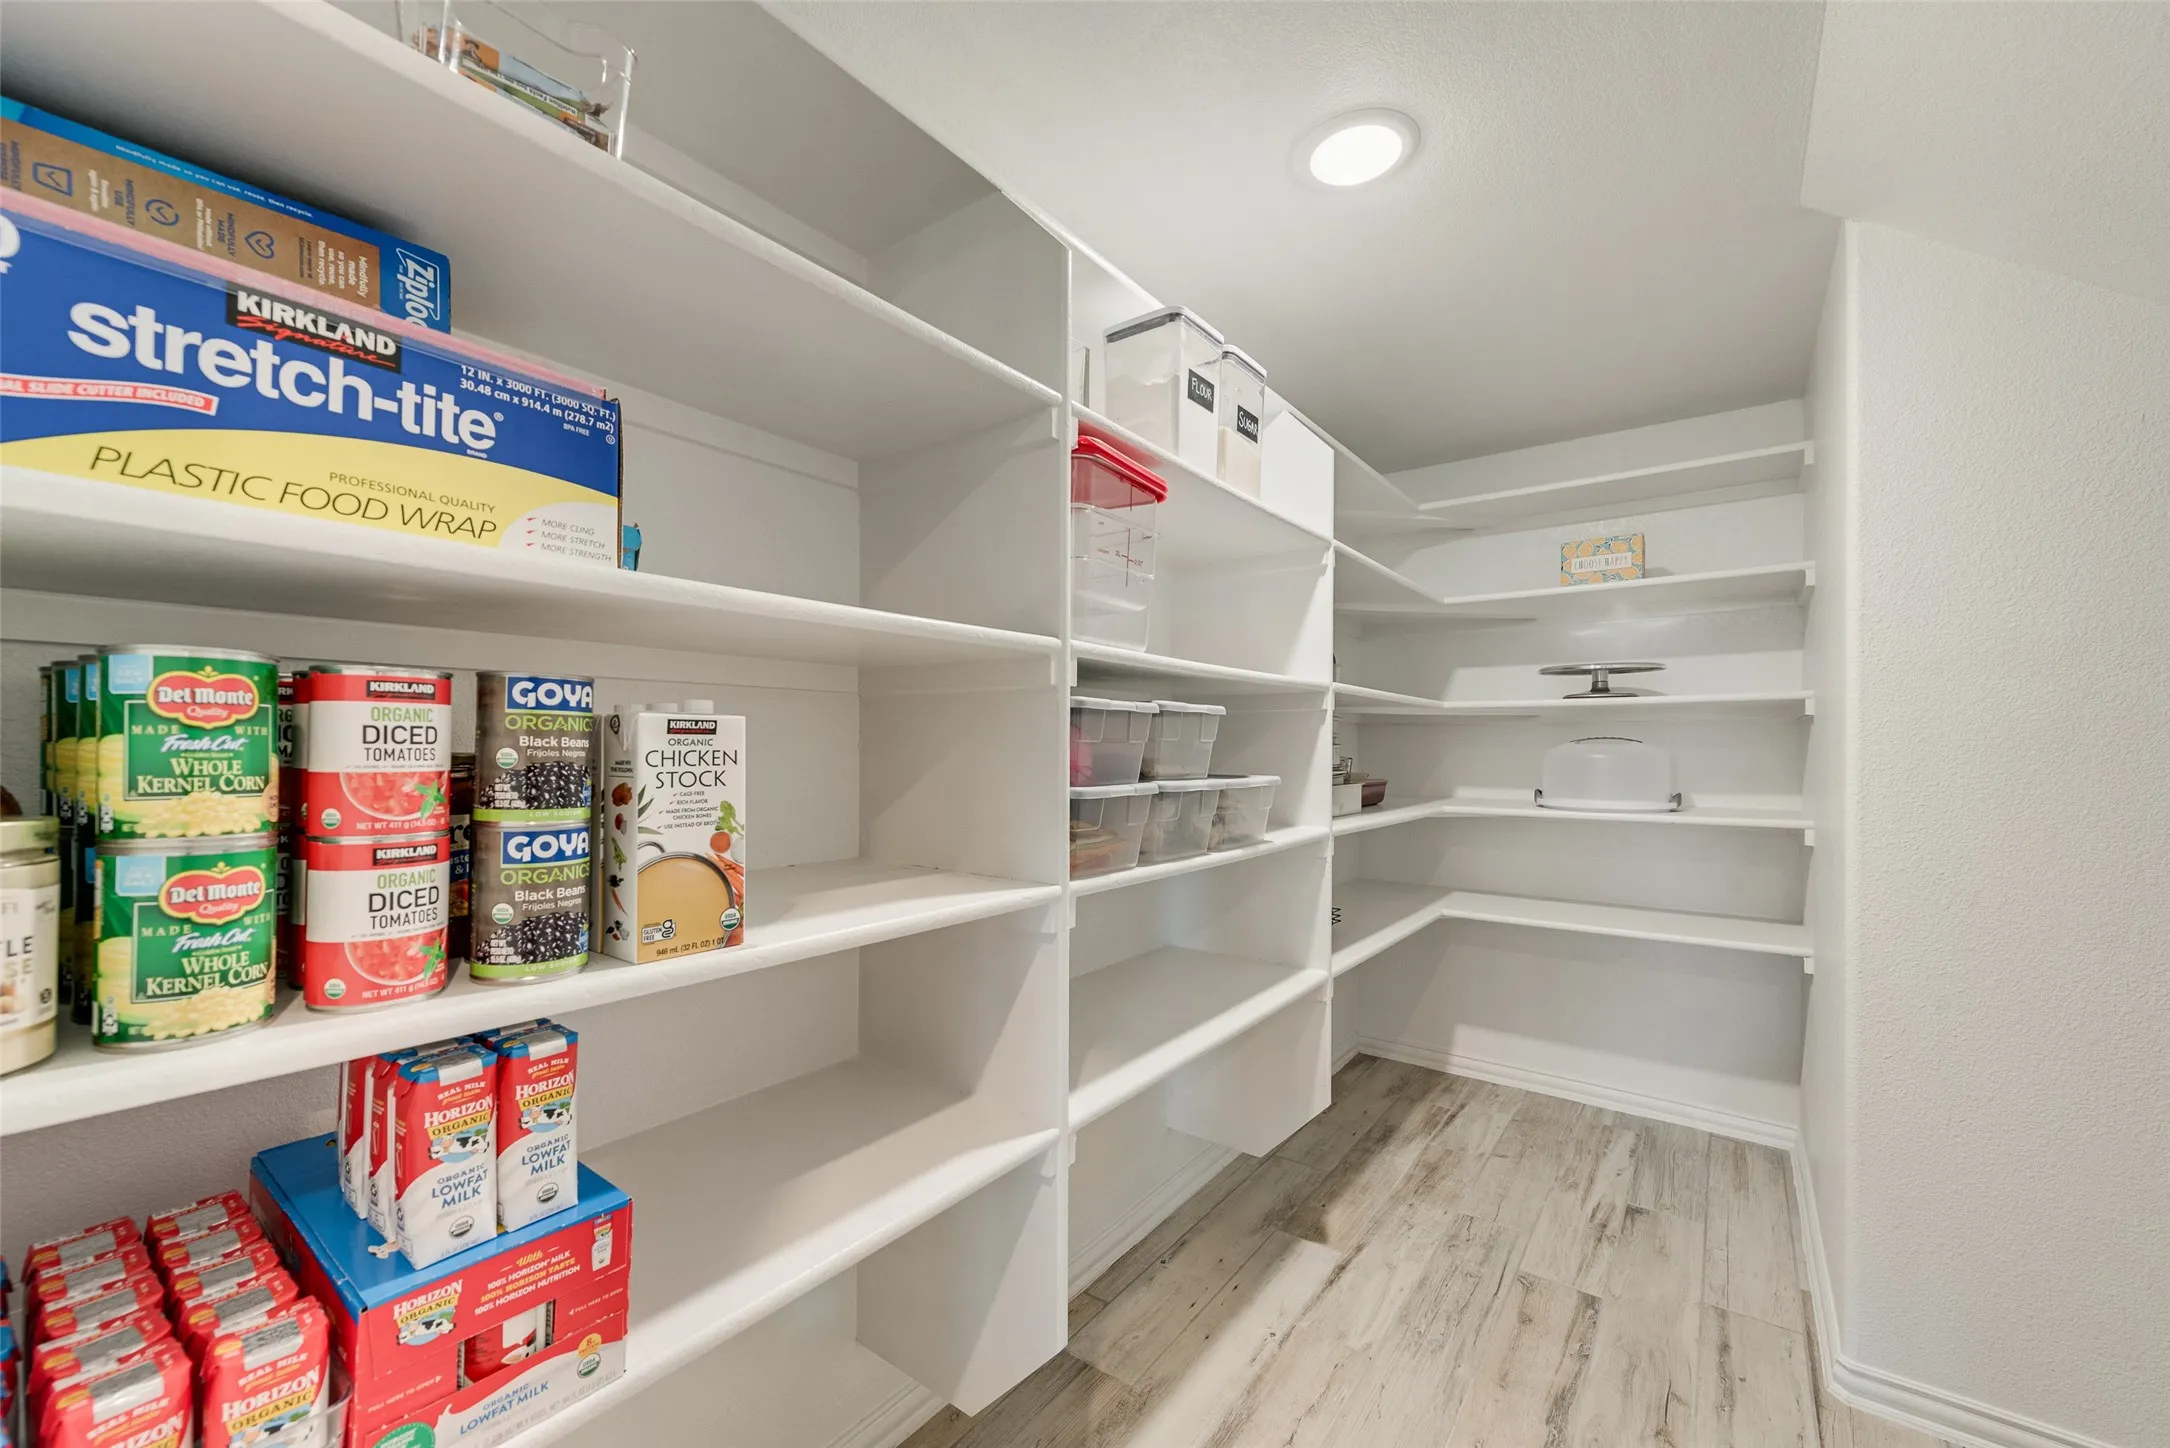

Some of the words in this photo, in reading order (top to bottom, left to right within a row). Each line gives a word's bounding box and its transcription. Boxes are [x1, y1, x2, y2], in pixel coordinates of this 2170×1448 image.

[114, 190, 123, 207] USE
[125, 179, 135, 226] MINDFULLY
[217, 219, 225, 243] MADE
[227, 213, 236, 257] MINDFULLY
[317, 240, 327, 257] then
[338, 276, 346, 289] can
[348, 260, 357, 286] made
[357, 255, 369, 298] Mindfully
[396, 258, 436, 327] Ziploc
[237, 290, 397, 356] KIRKLAND
[28, 381, 75, 395] SLIDE
[76, 383, 134, 398] CUTTER
[136, 387, 207, 407] INCLUDED
[460, 365, 475, 377] 12
[477, 369, 493, 384] IN.
[496, 375, 504, 387] x
[506, 378, 532, 395] 3000
[534, 385, 549, 401] FT.
[551, 393, 579, 411] (3000
[581, 401, 597, 416] SQ.
[600, 408, 616, 423] FT.)
[1190, 377, 1212, 401] FLOUR
[460, 378, 492, 396] 30.48
[494, 391, 510, 403] cm
[512, 395, 520, 406] x
[521, 397, 550, 414] 914.4
[552, 406, 563, 417] m
[564, 410, 595, 427] (278.7
[563, 423, 576, 432] BPA
[576, 426, 591, 437] FREE
[1237, 411, 1258, 437] SUGAR
[90, 446, 273, 501] PLASTIC
[279, 482, 389, 521] FOOD
[400, 504, 498, 539] WRAP
[329, 471, 435, 502] PROFESSIONAL
[439, 494, 496, 514] QUALITY
[541, 518, 567, 531] MORE
[570, 522, 595, 536] CLING
[541, 531, 567, 543] MORE
[569, 535, 606, 549] STRETCH
[540, 543, 567, 556] MORE
[568, 547, 612, 563] STRENGTH
[1574, 558, 1601, 570] CHOOSE
[1604, 555, 1628, 567] HAPPY
[157, 686, 190, 704] Del
[194, 688, 254, 706] Monte
[369, 681, 435, 694] KIRKLAND
[512, 680, 593, 708] GOYA
[186, 706, 229, 718] Quality
[370, 706, 434, 723] ORGANIC
[131, 725, 181, 735] MADE
[234, 726, 269, 736] WITH
[362, 725, 438, 745] DICED
[669, 720, 716, 730] KIRKLAND
[161, 734, 217, 752] Fresh
[519, 736, 558, 747] Black
[561, 737, 589, 748] Beans
[667, 738, 714, 747] ORGANIC
[364, 747, 436, 762] TOMATOES
[527, 748, 560, 758] Frijoles
[562, 749, 586, 758] Negros
[645, 749, 738, 767] CHICKEN
[170, 758, 243, 776] WHOLE
[136, 775, 217, 794] KERNEL
[219, 774, 265, 791] CORN
[655, 770, 727, 789] STOCK
[356, 822, 373, 830] NET
[374, 821, 388, 829] WT
[376, 845, 436, 859] KIRKLAND
[507, 831, 589, 863] GOYA
[377, 868, 436, 890] ORGANIC
[170, 884, 204, 903] Del
[208, 881, 261, 901] Monte
[368, 885, 440, 913] DICED
[514, 889, 554, 901] Black
[556, 884, 586, 898] Beans
[199, 902, 240, 914] Quality
[522, 901, 555, 912] Frijoles
[557, 898, 582, 909] Negros
[370, 907, 438, 930] TOMATOES
[141, 925, 192, 937] MADE
[643, 928, 662, 936] GLUTEN
[172, 932, 223, 953] Fresh
[656, 948, 669, 957] 946
[680, 943, 690, 953] (32
[691, 942, 700, 950] FL
[180, 951, 250, 975] WHOLE
[145, 975, 225, 996] KERNEL
[228, 962, 268, 985] CORN
[362, 989, 378, 999] NET
[380, 987, 392, 997] WT
[527, 1062, 549, 1074] REAL
[551, 1057, 569, 1066] MILK
[437, 1086, 462, 1100] REAL
[464, 1081, 486, 1091] MILK
[515, 1069, 574, 1100] HORIZON
[522, 1087, 572, 1108] ORGANIC
[424, 1093, 493, 1128] HORIZON
[432, 1113, 488, 1136] ORGANIC
[522, 1140, 571, 1166] LOWFAT
[527, 1134, 569, 1153] ORGANIC
[437, 1163, 485, 1185] ORGANIC
[530, 1154, 565, 1176] MILK
[432, 1169, 488, 1199] LOWFAT
[441, 1185, 481, 1209] MILK
[516, 1250, 544, 1267] With
[480, 1289, 504, 1303] 100%
[505, 1270, 547, 1292] HORIZON
[548, 1257, 576, 1275] TASTE
[487, 1277, 507, 1290] 100%
[508, 1262, 549, 1281] HORIZON
[550, 1250, 571, 1264] MILK
[393, 1279, 464, 1320] HORIZON
[474, 1301, 496, 1316] 100%
[495, 1283, 536, 1307] HORIZON
[537, 1264, 581, 1289] NUTRITION
[400, 1297, 455, 1325] ORGANIC
[574, 1304, 587, 1313] PULL
[222, 1365, 320, 1422] HORIZON
[482, 1383, 529, 1411] ORGANIC
[232, 1390, 312, 1431] ORGANIC
[459, 1400, 513, 1435] LOWFAT
[516, 1381, 549, 1405] MILK
